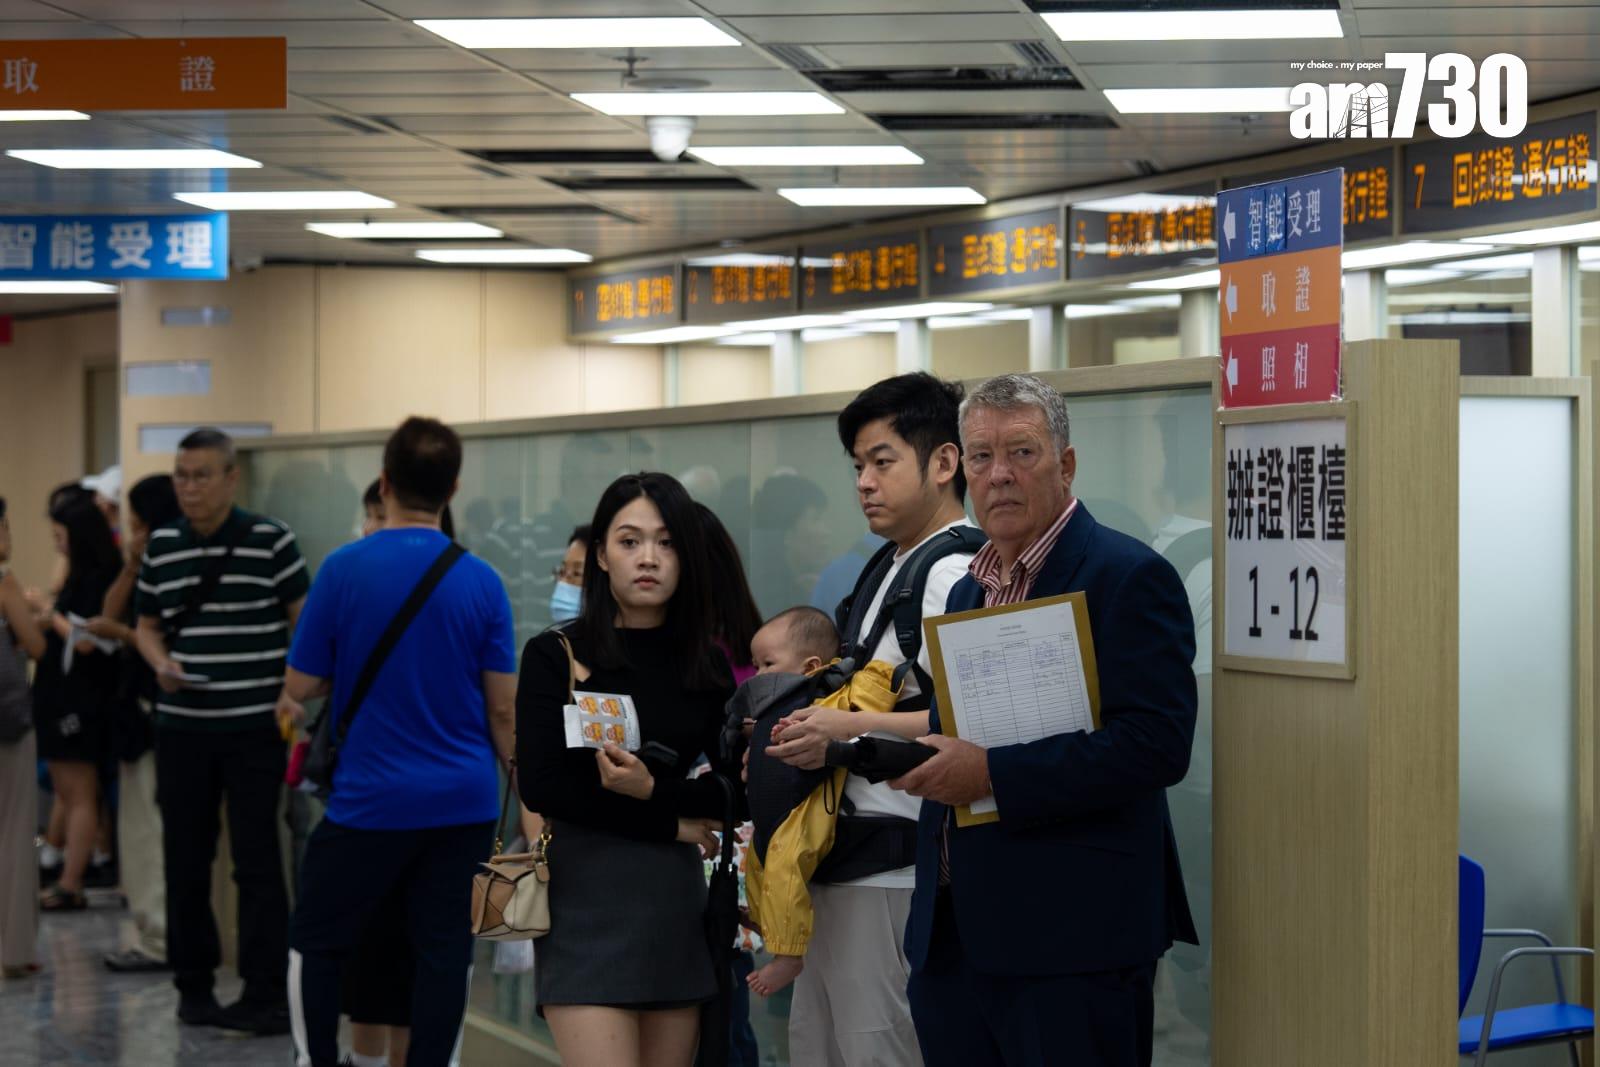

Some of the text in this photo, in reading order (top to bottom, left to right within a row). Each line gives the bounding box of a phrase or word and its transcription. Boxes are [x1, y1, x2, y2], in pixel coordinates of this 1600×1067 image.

[1343, 167, 1389, 226] 行證
[1413, 163, 1427, 209] 7
[1248, 187, 1321, 250] 智能受理
[0, 220, 214, 270] 智能受理
[1261, 266, 1312, 318] 取證
[1261, 341, 1309, 392] 照相
[1227, 443, 1345, 541] 辦證櫃檯
